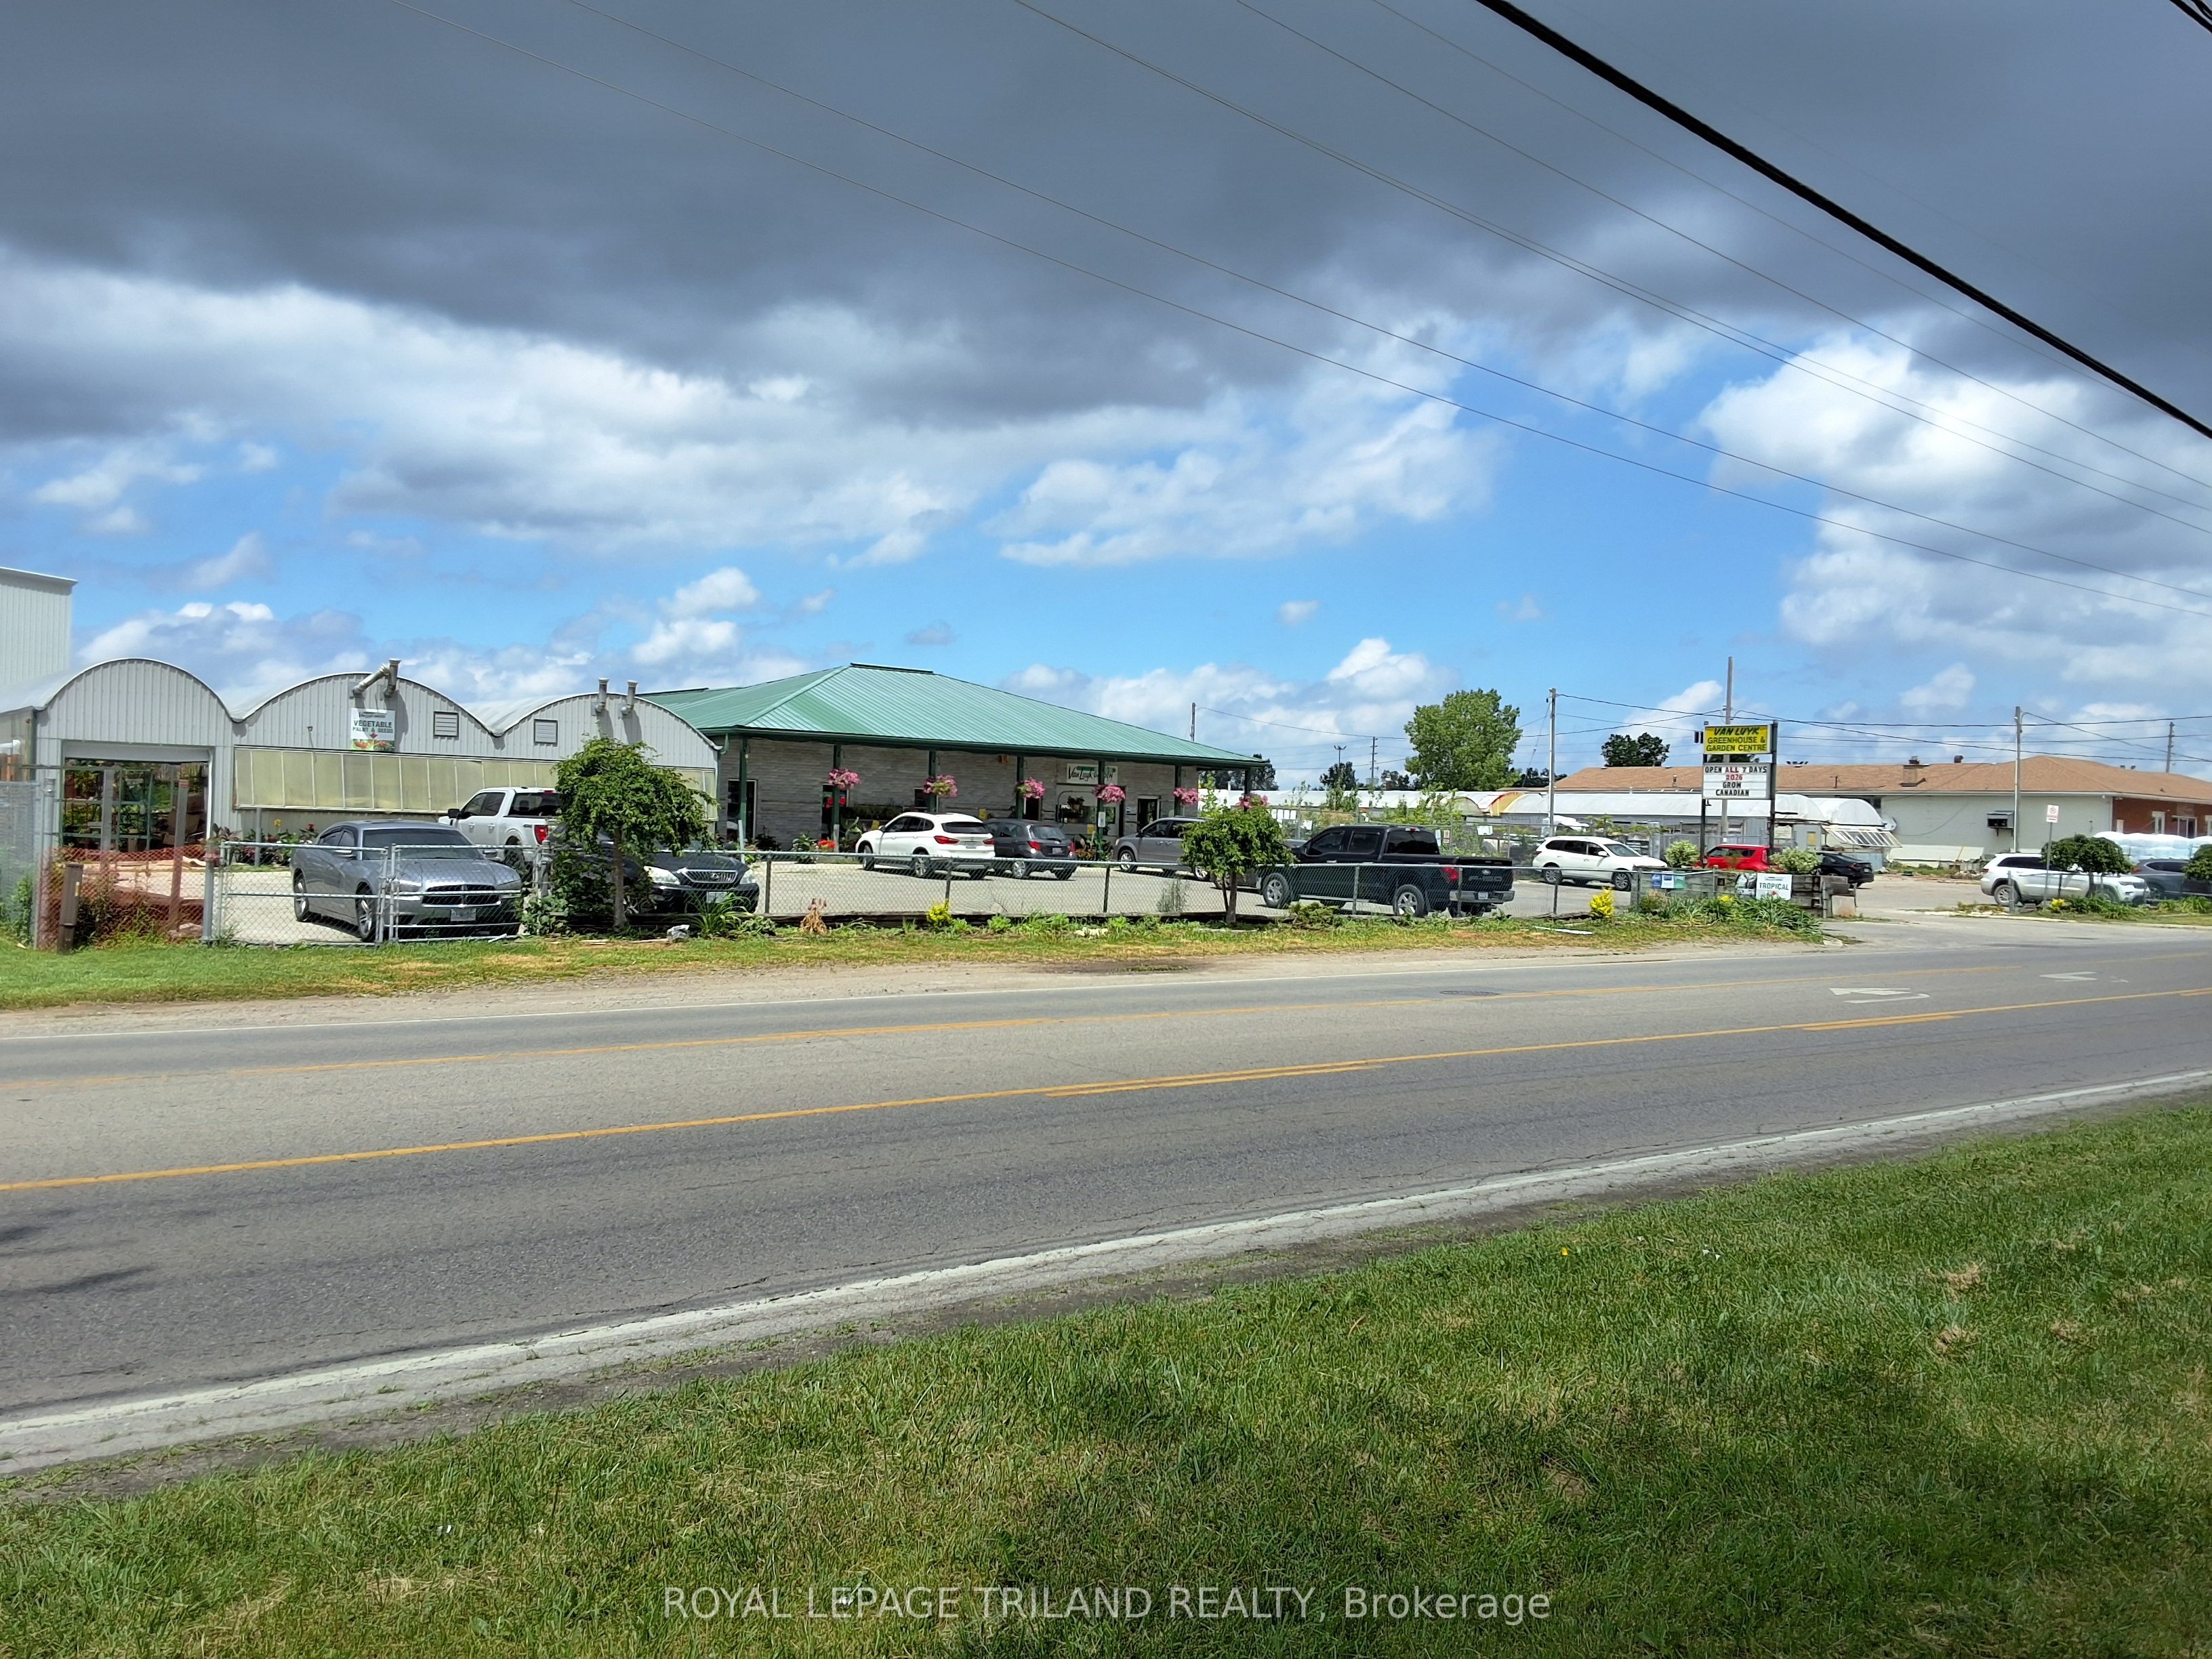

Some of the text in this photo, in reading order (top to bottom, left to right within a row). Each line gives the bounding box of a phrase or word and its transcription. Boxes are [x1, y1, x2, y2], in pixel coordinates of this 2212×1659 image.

[353, 720, 392, 728] VEGETABLE
[1714, 726, 1760, 736] VAN LUYK
[1707, 736, 1758, 744] GREENHOUSE
[1738, 743, 1767, 752] CENTRE
[1759, 882, 1789, 890] TROPICAL
